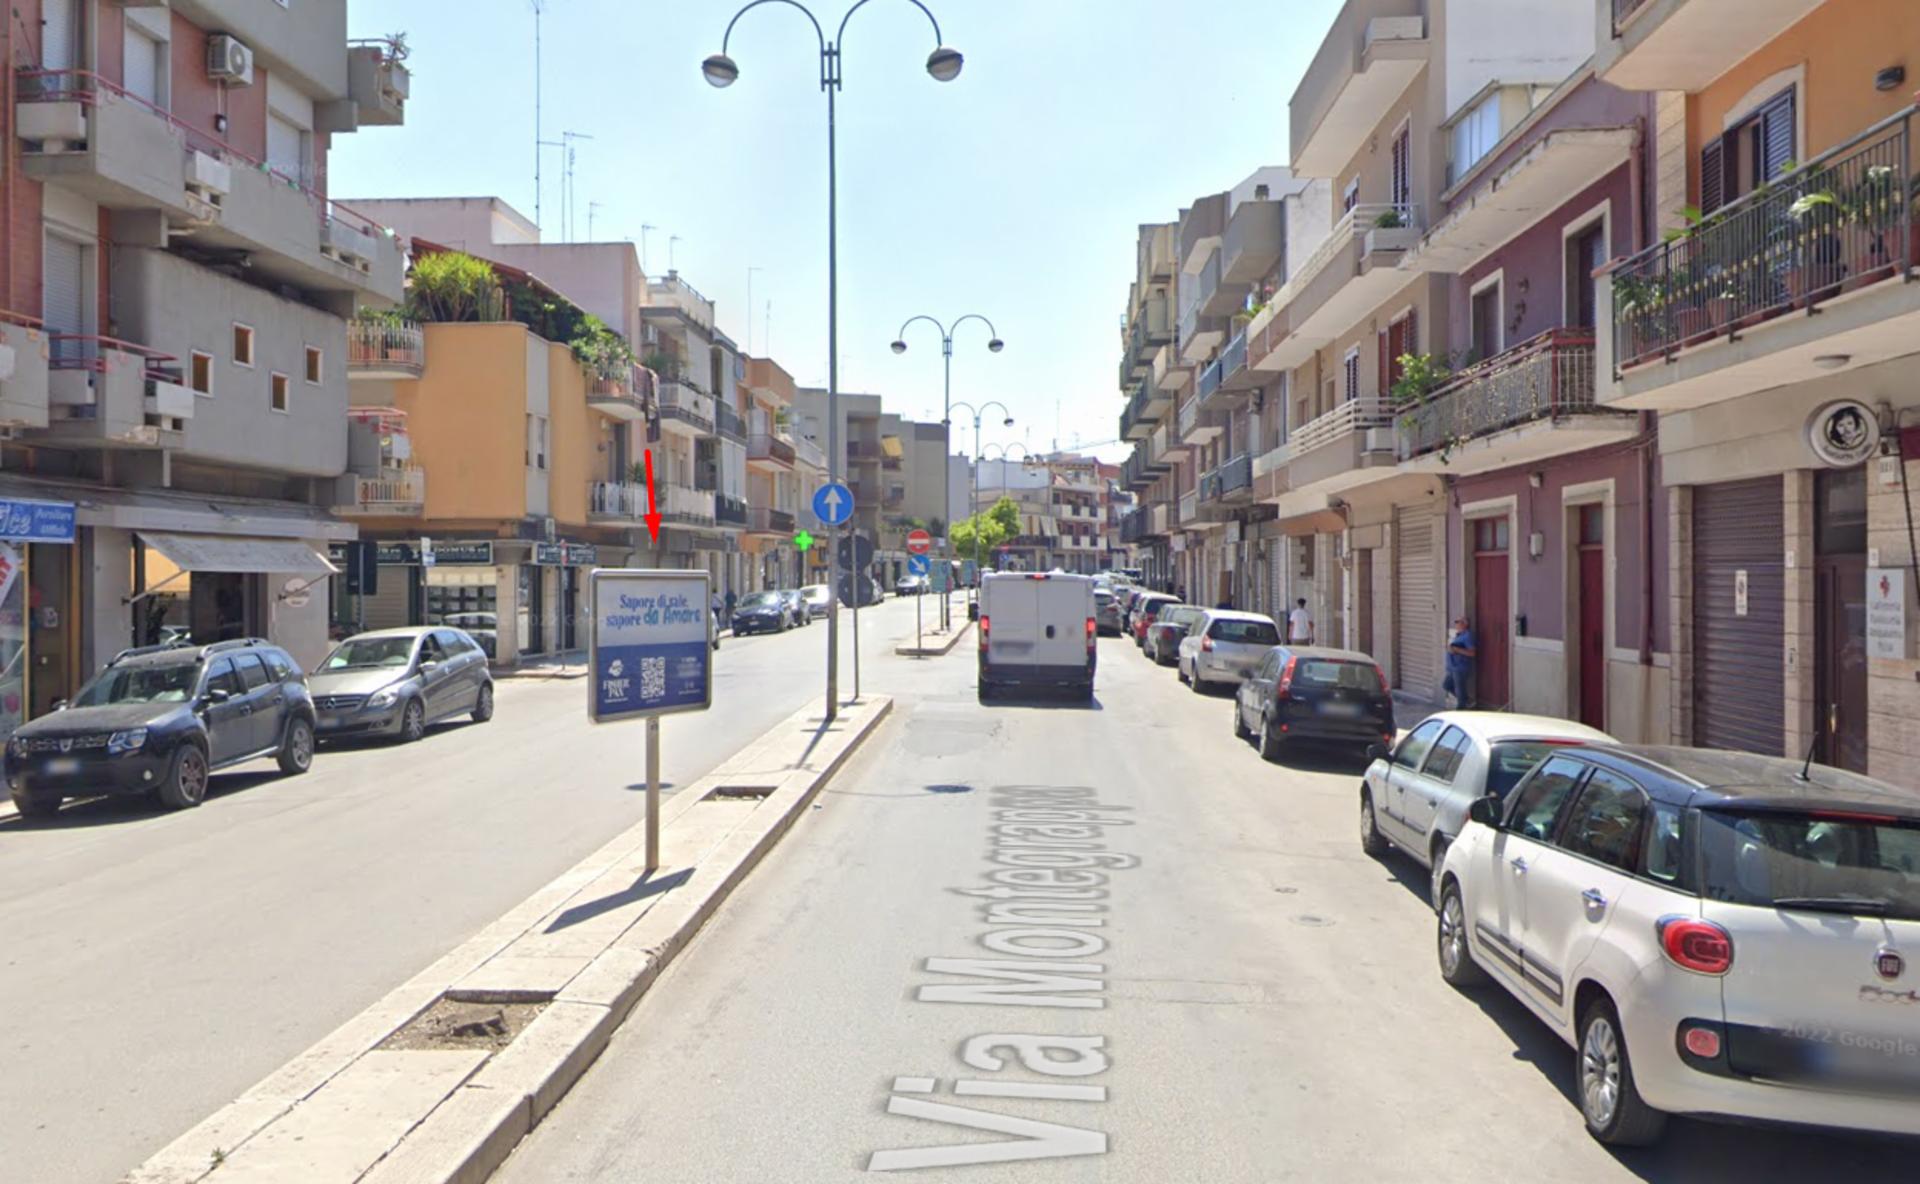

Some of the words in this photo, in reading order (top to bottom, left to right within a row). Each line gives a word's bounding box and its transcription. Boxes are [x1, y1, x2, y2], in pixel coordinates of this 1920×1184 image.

[619, 594, 655, 612] Sapore
[657, 594, 666, 608] di
[606, 614, 641, 629] sapore
[643, 608, 659, 624] da
